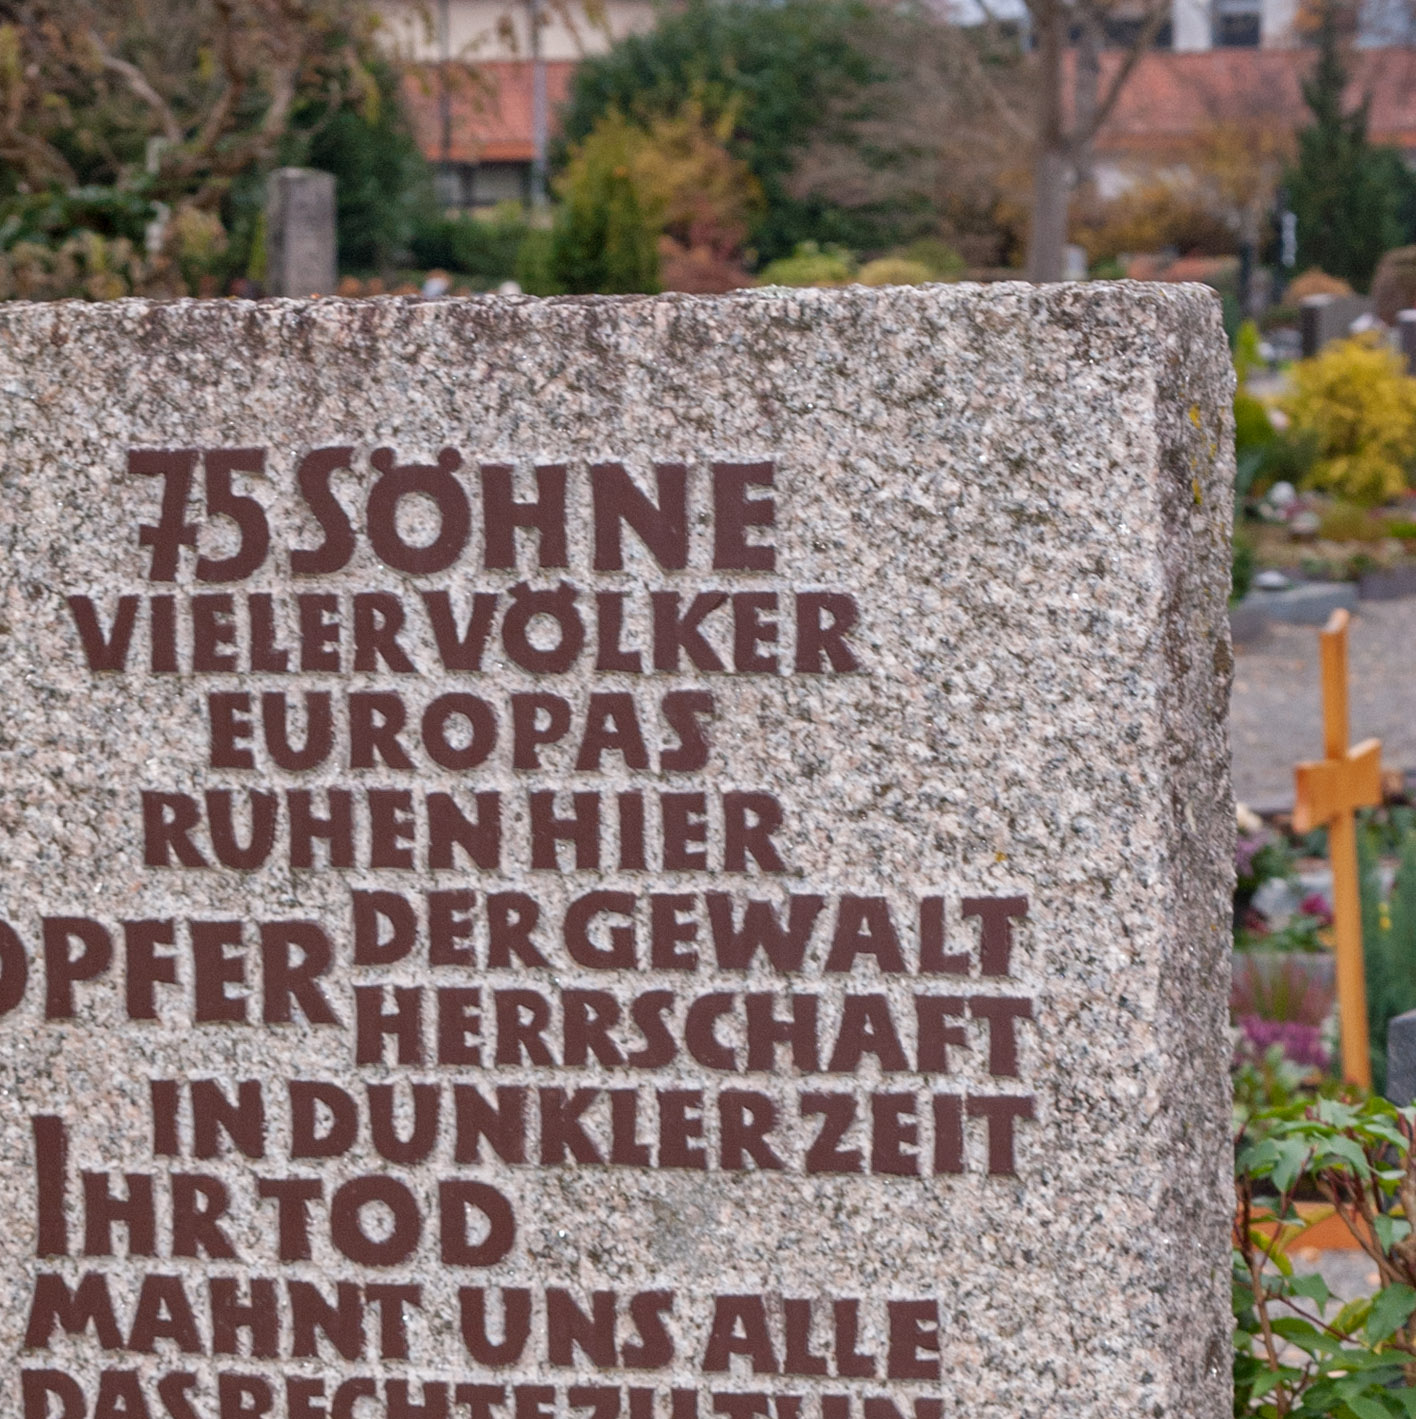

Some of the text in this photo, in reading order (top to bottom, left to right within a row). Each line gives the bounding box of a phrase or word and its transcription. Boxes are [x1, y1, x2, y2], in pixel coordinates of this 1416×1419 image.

[127, 447, 776, 584] 75 SÖHNE
[65, 582, 858, 676] VIELER VÖLKER
[207, 691, 715, 774] EUROPAS
[140, 788, 785, 874] RUHEN HIER
[351, 890, 549, 970] DER
[562, 890, 1030, 978] GEWALT
[354, 986, 1033, 1078] HERRSCHAFT
[149, 1079, 1034, 1178] IN DUNKLER ZEIT
[31, 1115, 517, 1269] IHR TOD
[23, 1272, 942, 1382] MAHNT UNS ALLE
